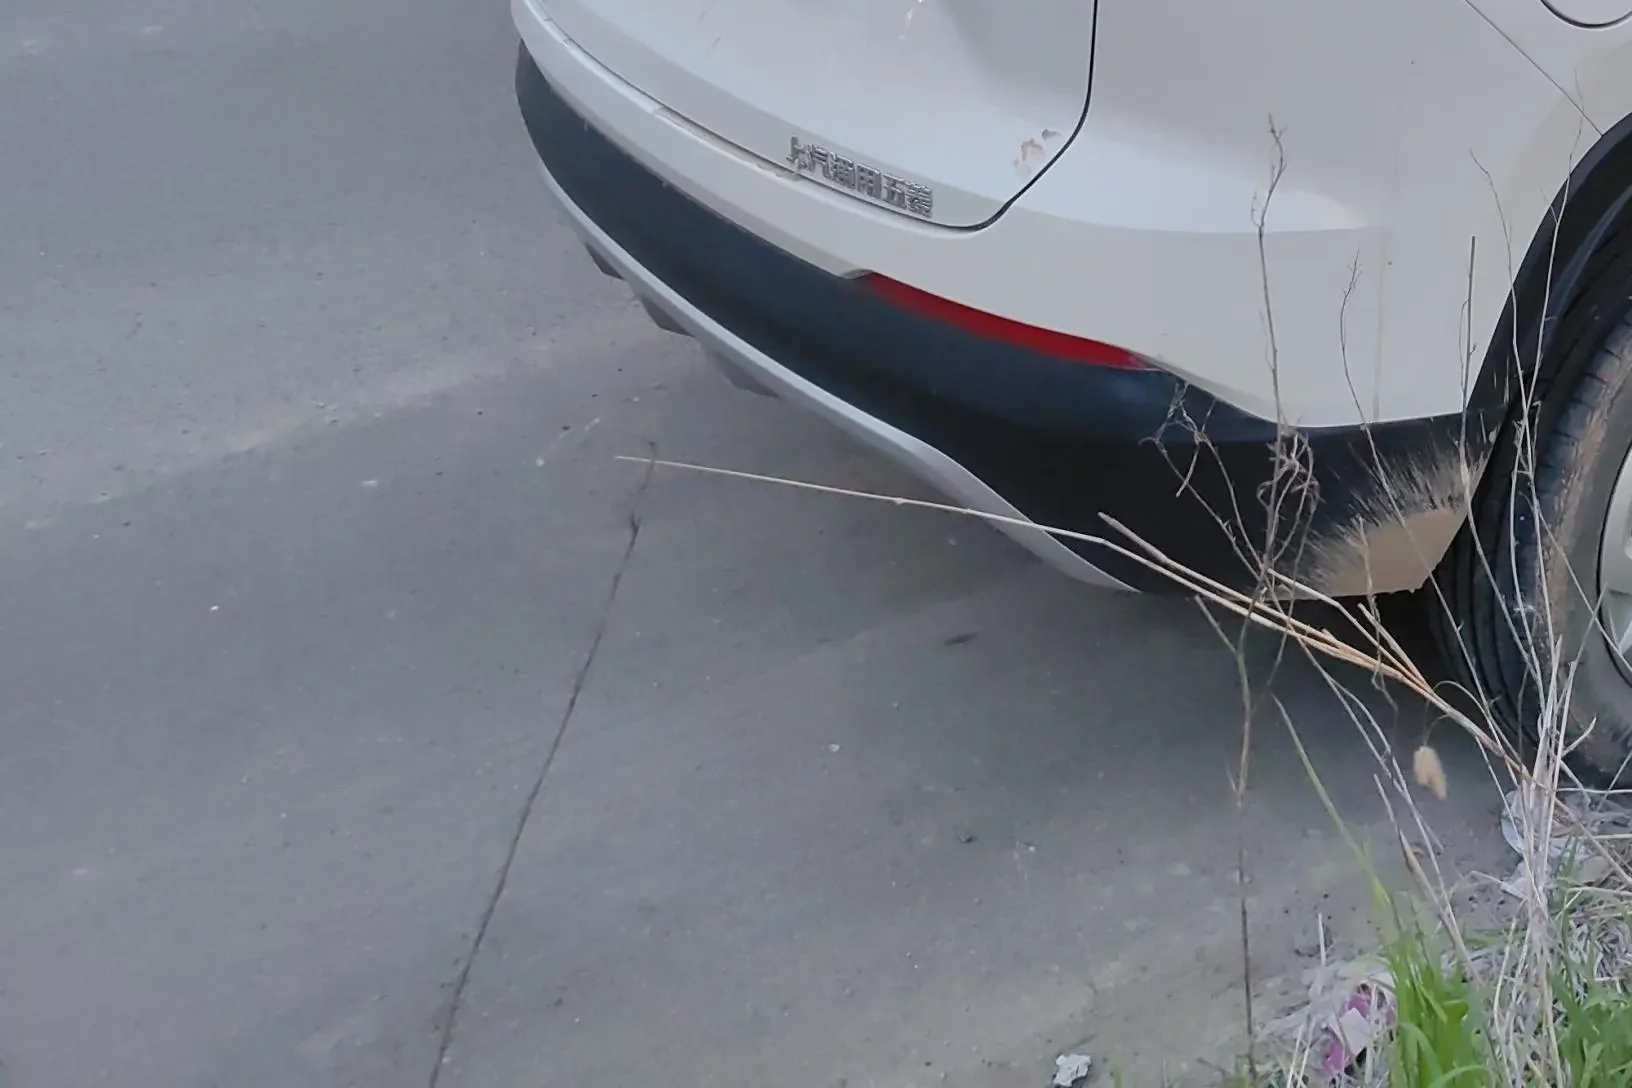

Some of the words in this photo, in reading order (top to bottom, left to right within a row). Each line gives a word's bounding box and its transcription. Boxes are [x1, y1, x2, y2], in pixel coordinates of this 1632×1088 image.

[784, 135, 933, 218] 上汽通用五菱
